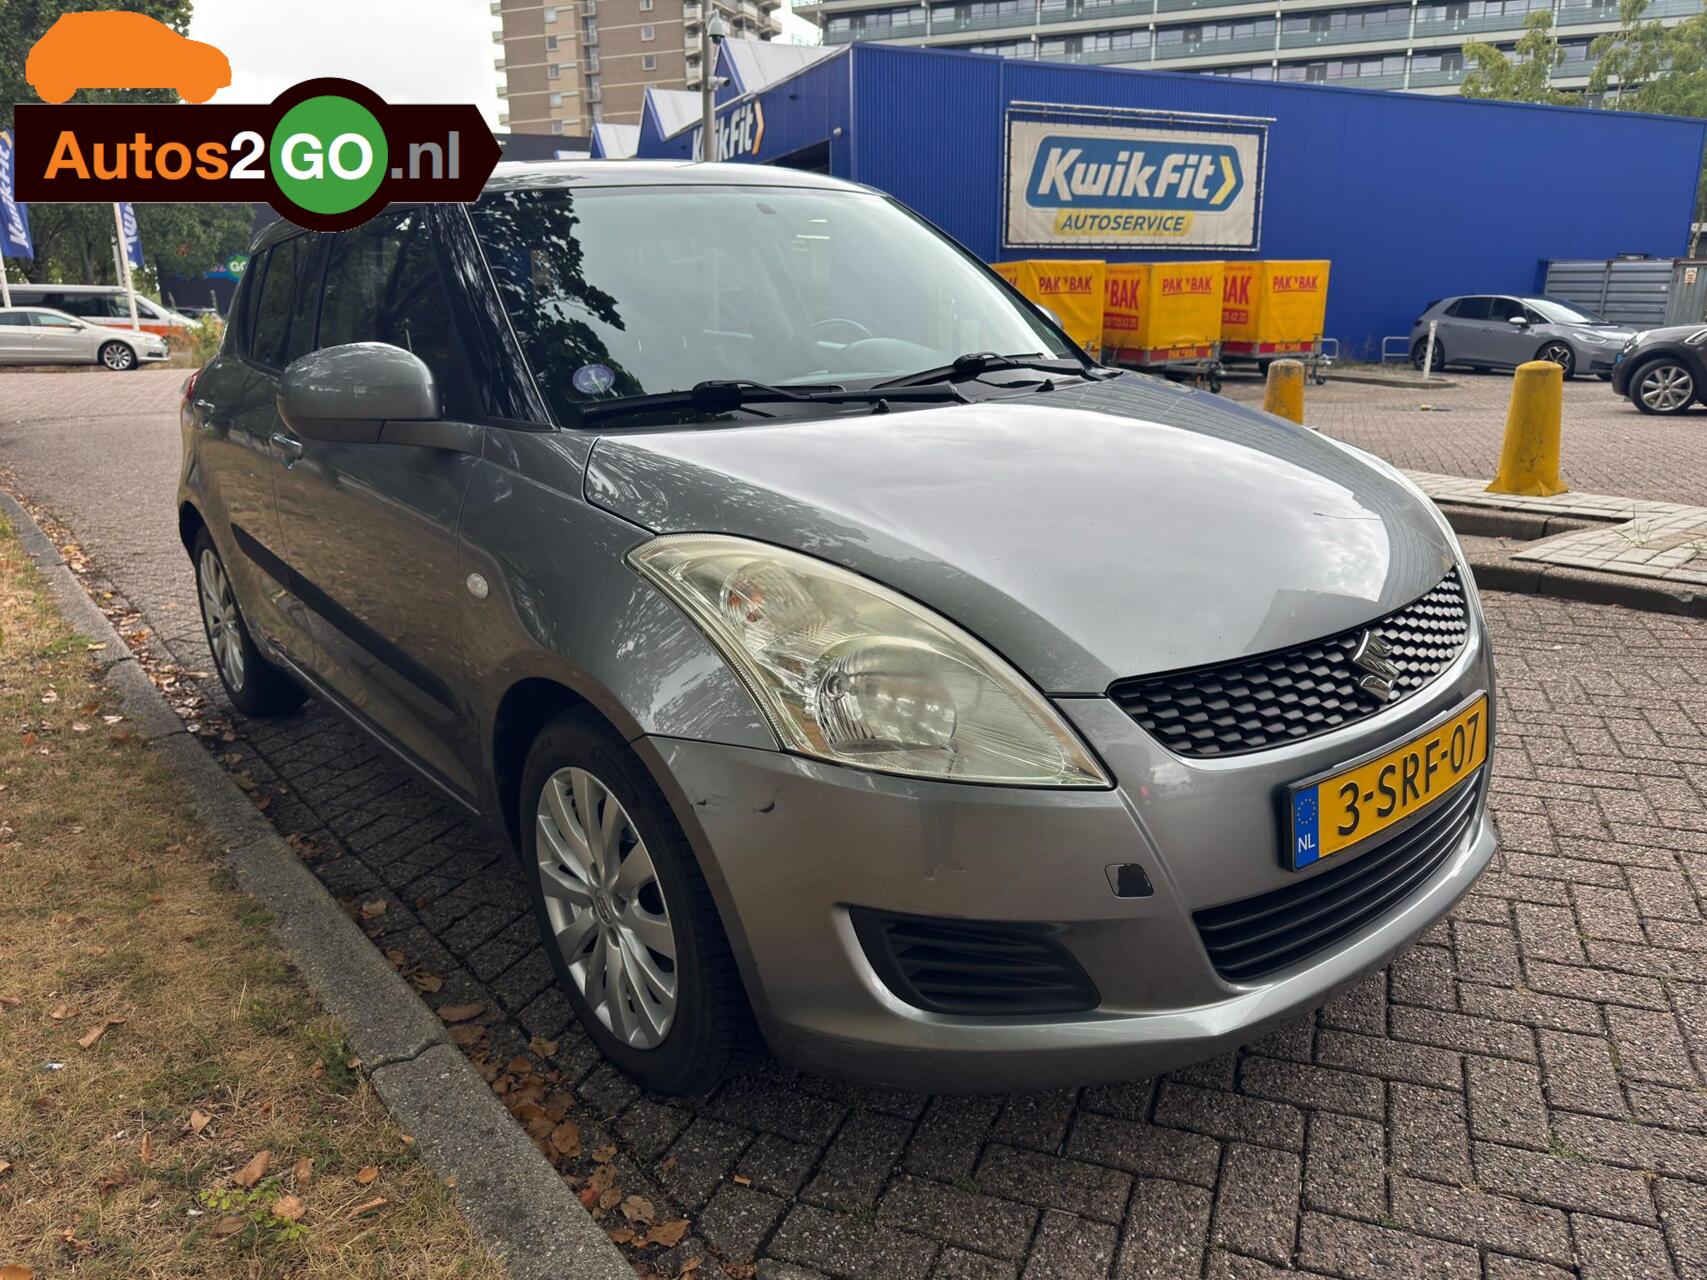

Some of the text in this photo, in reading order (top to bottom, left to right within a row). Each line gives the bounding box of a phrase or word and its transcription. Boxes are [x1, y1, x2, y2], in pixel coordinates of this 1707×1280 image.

[1060, 214, 1185, 232] AUTOSERVICE
[1039, 276, 1060, 292] PAK
[1070, 276, 1092, 291] BAK
[1162, 277, 1184, 293] PAK
[1190, 275, 1212, 291] BAK
[1273, 275, 1293, 291] PAK
[1299, 275, 1318, 289] BAK
[1338, 711, 1479, 836] 3-SRF-07
[1297, 832, 1316, 854] NL
